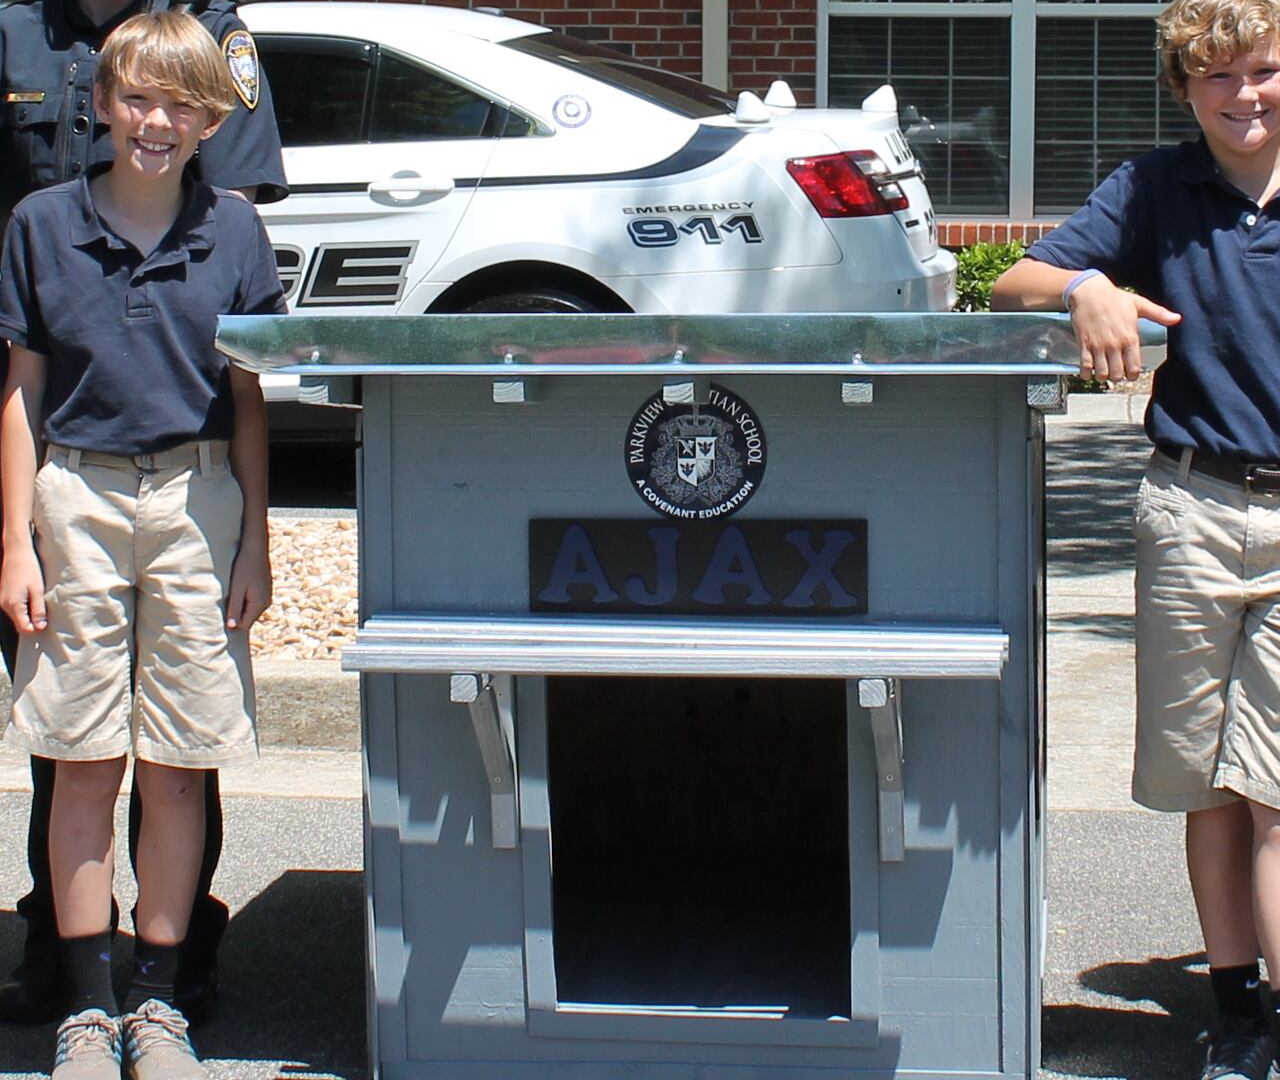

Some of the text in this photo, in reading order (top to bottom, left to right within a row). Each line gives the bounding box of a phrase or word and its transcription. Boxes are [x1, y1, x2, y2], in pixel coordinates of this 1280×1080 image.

[622, 201, 755, 215] EMERGENCY
[626, 212, 765, 248] 911
[629, 398, 665, 464] PARKVIEW
[736, 412, 763, 465] SCHOOL
[636, 479, 754, 519] A COVENANT EDUCATION
[537, 523, 859, 607] AJAX
